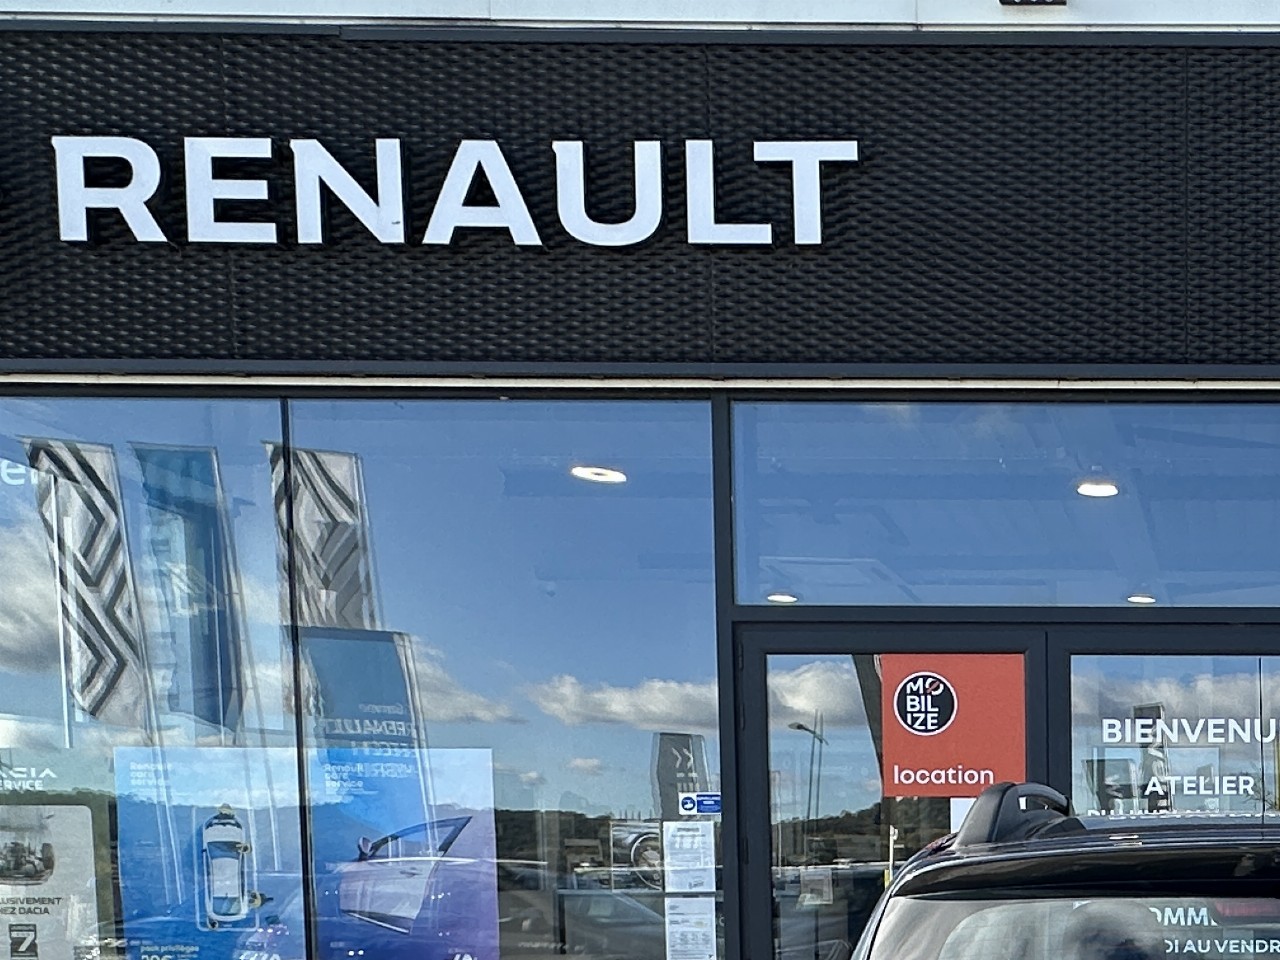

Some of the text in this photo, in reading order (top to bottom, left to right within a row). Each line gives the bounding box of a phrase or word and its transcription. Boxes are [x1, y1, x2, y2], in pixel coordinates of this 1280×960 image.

[50, 136, 860, 246] RENAULT
[894, 765, 994, 784] location
[1145, 775, 1255, 796] ATELIER
[19, 906, 49, 915] DACIA
[1182, 939, 1211, 953] AU
